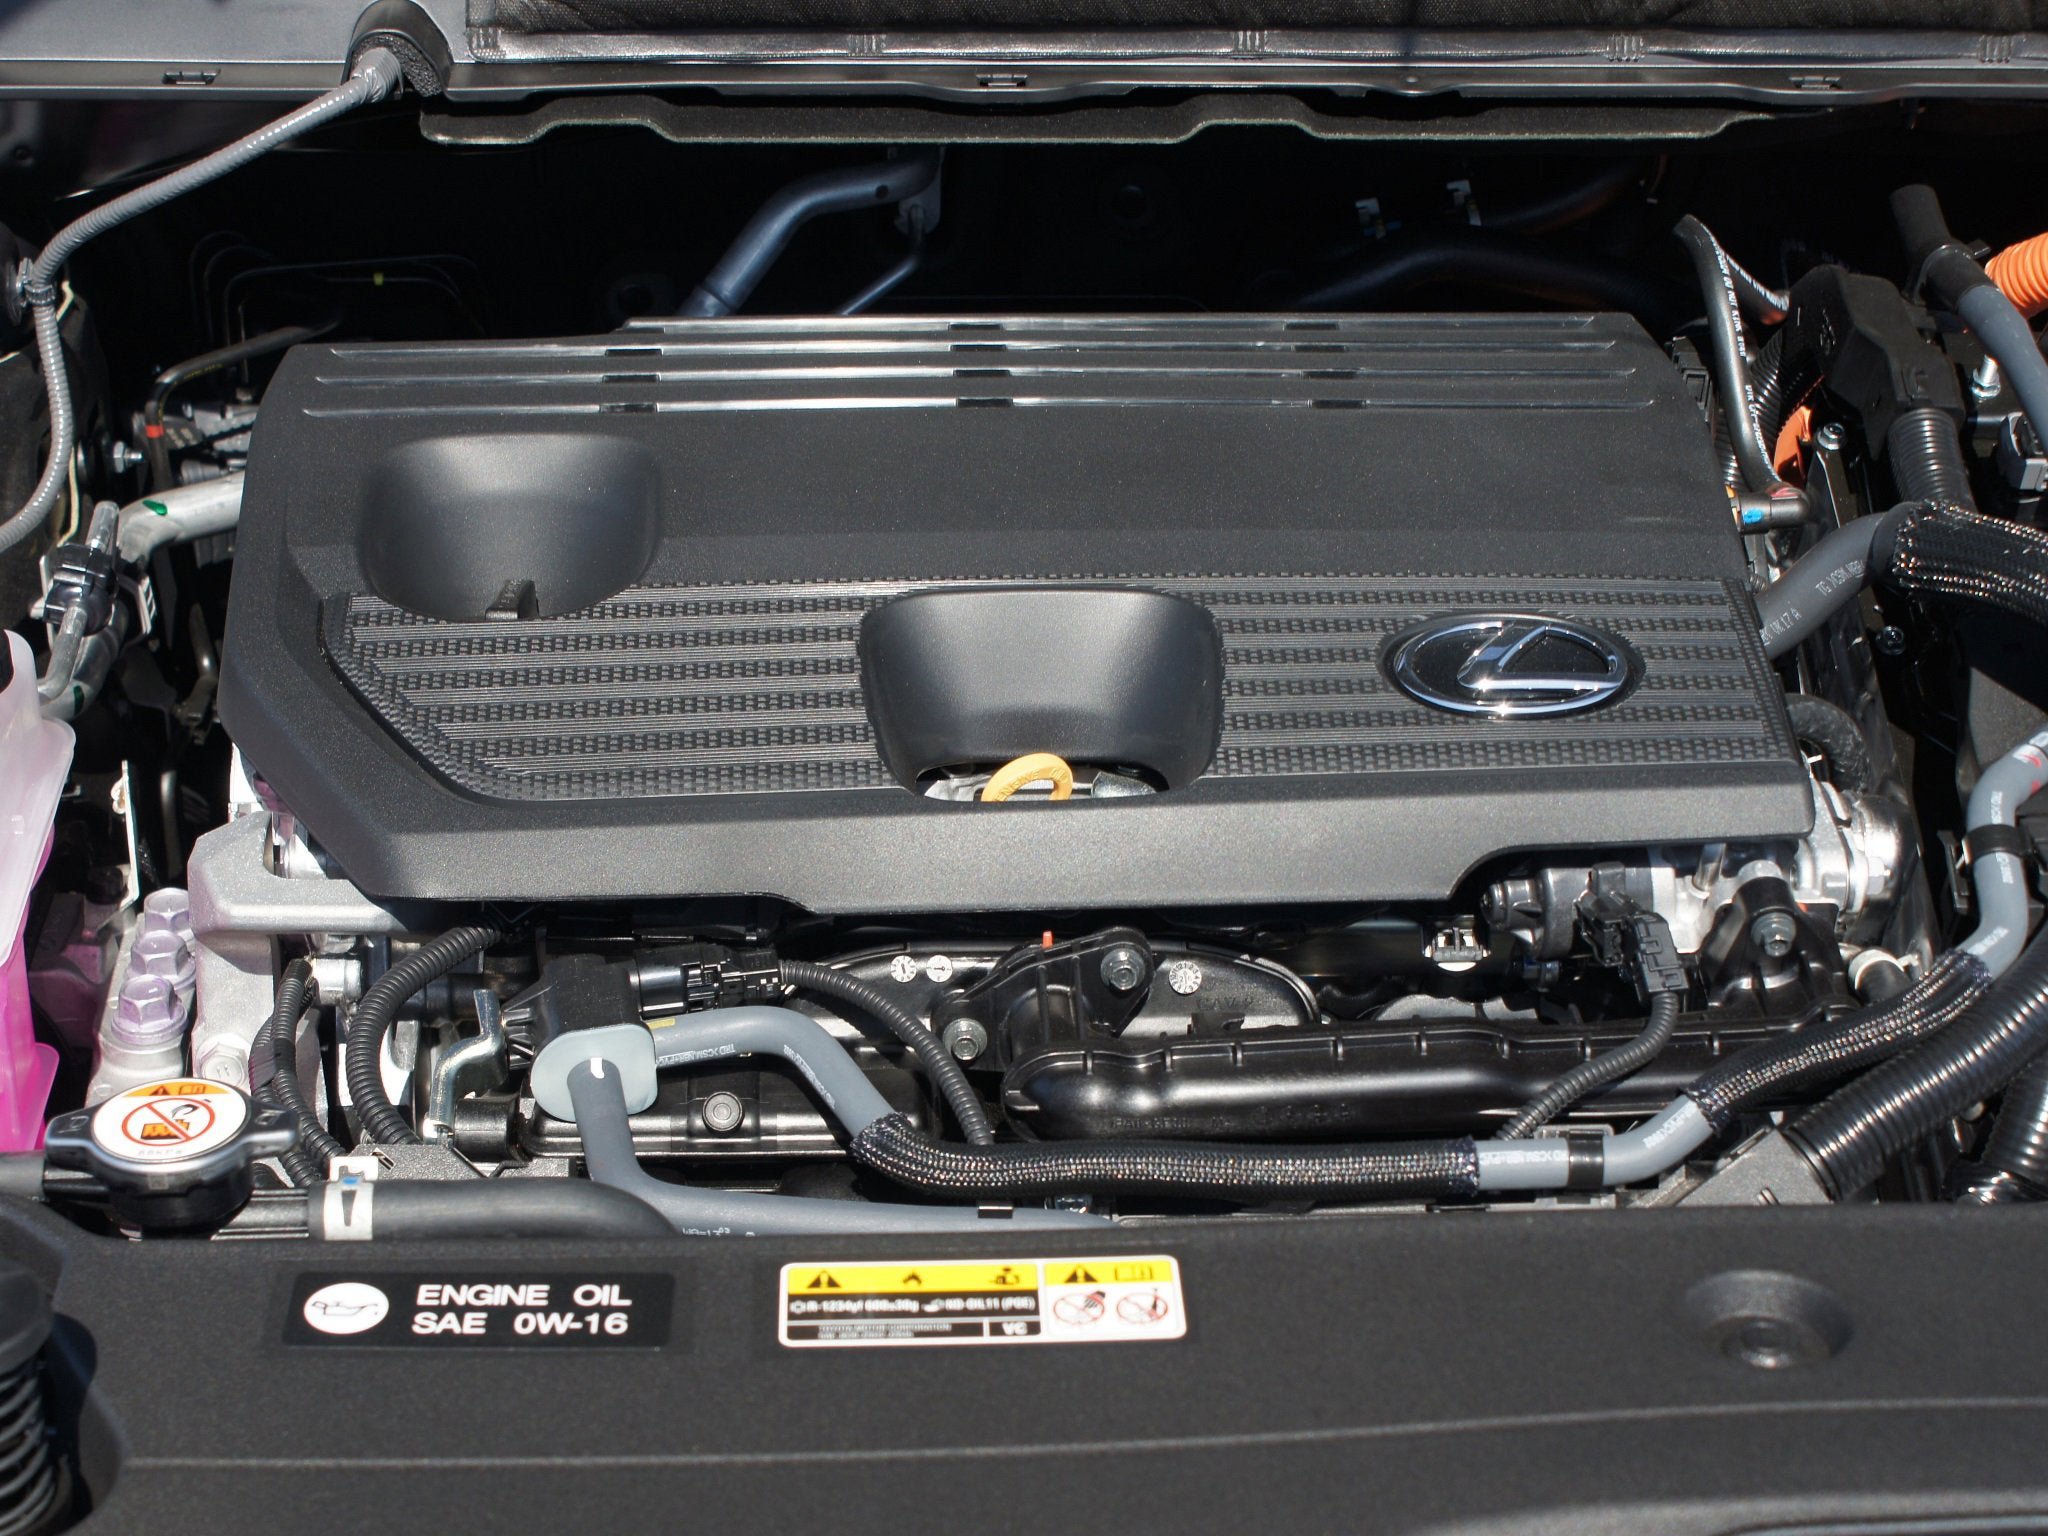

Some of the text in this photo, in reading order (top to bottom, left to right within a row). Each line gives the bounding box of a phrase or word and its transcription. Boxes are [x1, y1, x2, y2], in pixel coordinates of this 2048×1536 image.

[416, 1284, 632, 1306] ENGINE OIL
[411, 1312, 628, 1334] SAE 0W-16
